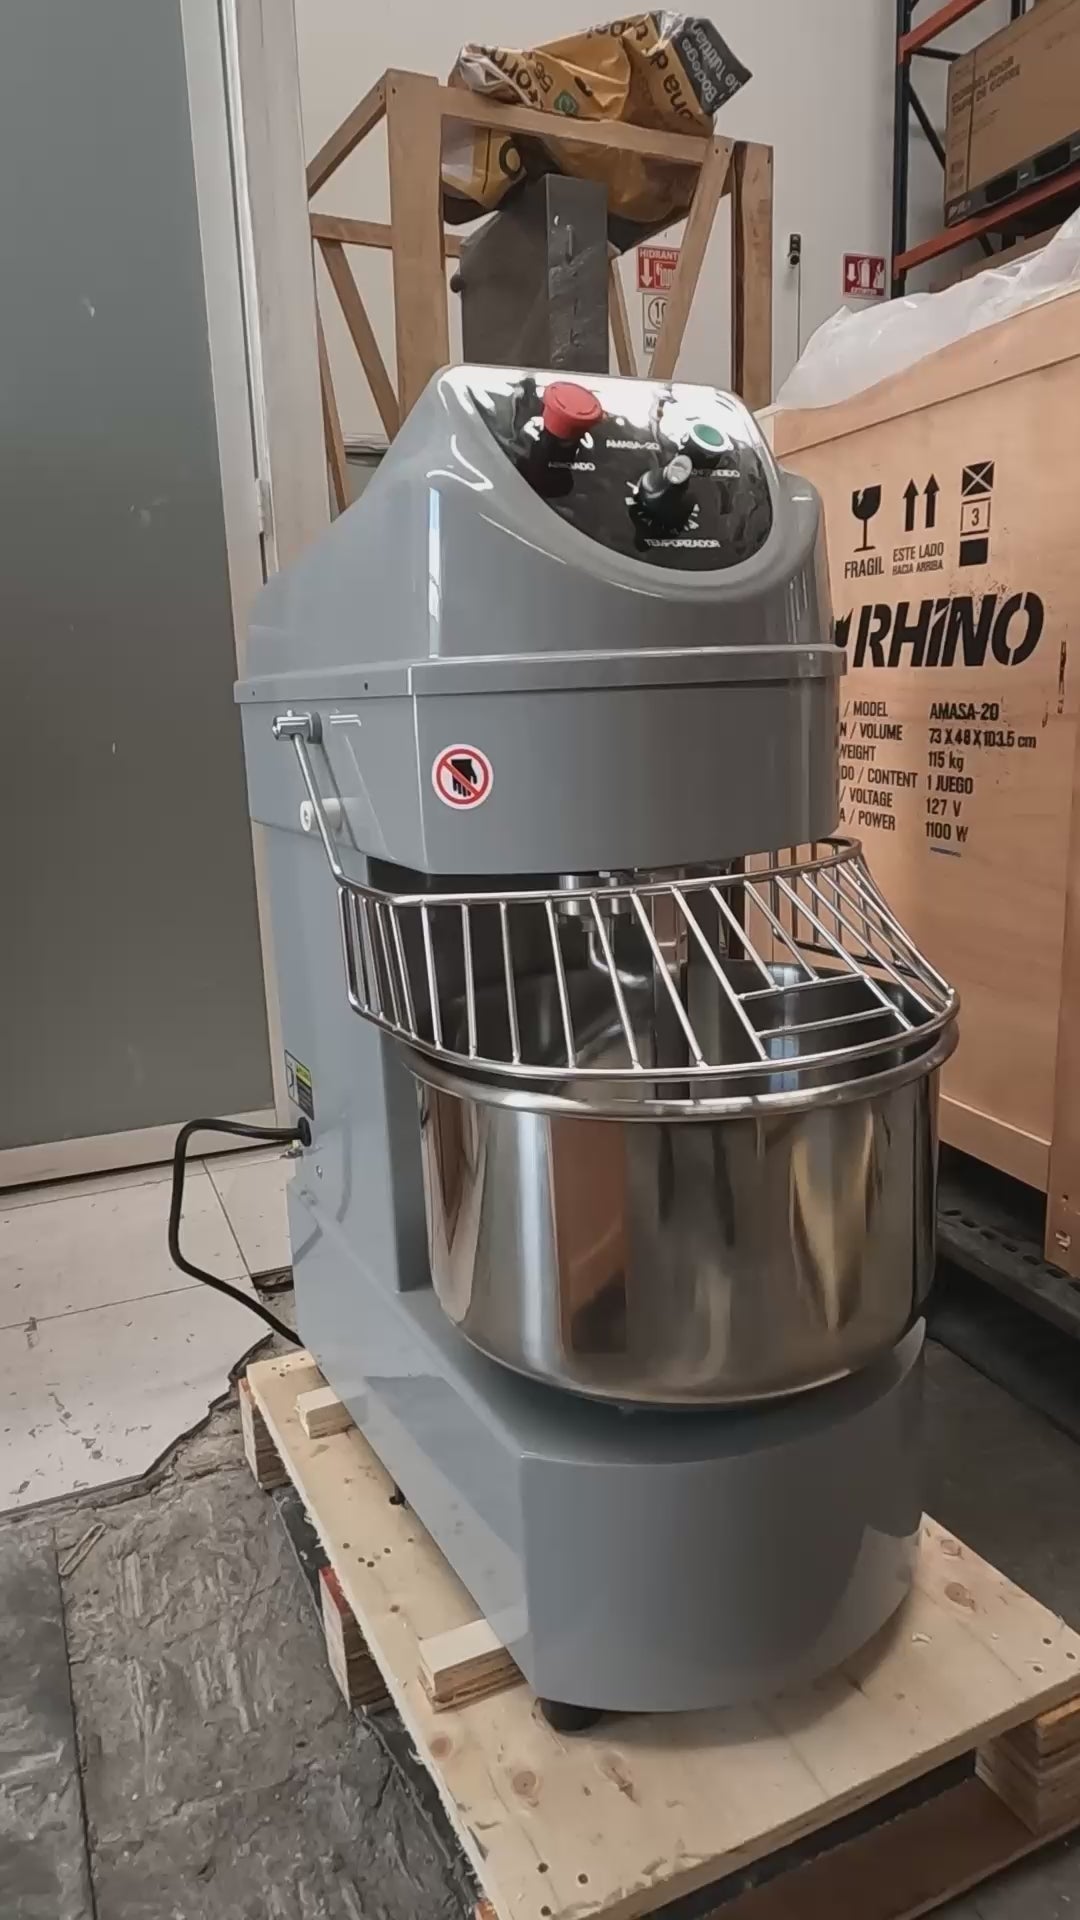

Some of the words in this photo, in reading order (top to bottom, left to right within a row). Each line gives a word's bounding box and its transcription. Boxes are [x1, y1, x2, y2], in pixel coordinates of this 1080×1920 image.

[639, 248, 679, 261] HIDRANT
[971, 507, 981, 527] 3
[892, 546, 916, 563] ESTE
[918, 541, 945, 560] LADO
[844, 556, 885, 579] FRAGIL
[892, 564, 914, 576] HACIA
[916, 559, 944, 571] ARRIBA
[852, 591, 1045, 668] RHINO
[853, 701, 888, 717] MODEL
[929, 701, 1000, 721] AMASA-20
[860, 722, 904, 741] VOLUME
[928, 728, 942, 744] 73
[955, 728, 971, 746] 48
[1017, 736, 1037, 749] cm
[928, 751, 945, 769] 115
[948, 751, 965, 773] kg
[867, 768, 918, 788] CONTENT
[935, 775, 974, 795] JUEGO
[849, 787, 893, 808] VOLTAGE
[926, 797, 947, 816] 127
[953, 800, 962, 818] V
[858, 810, 896, 832] POWER
[925, 821, 951, 840] 1100
[956, 824, 969, 843] W
